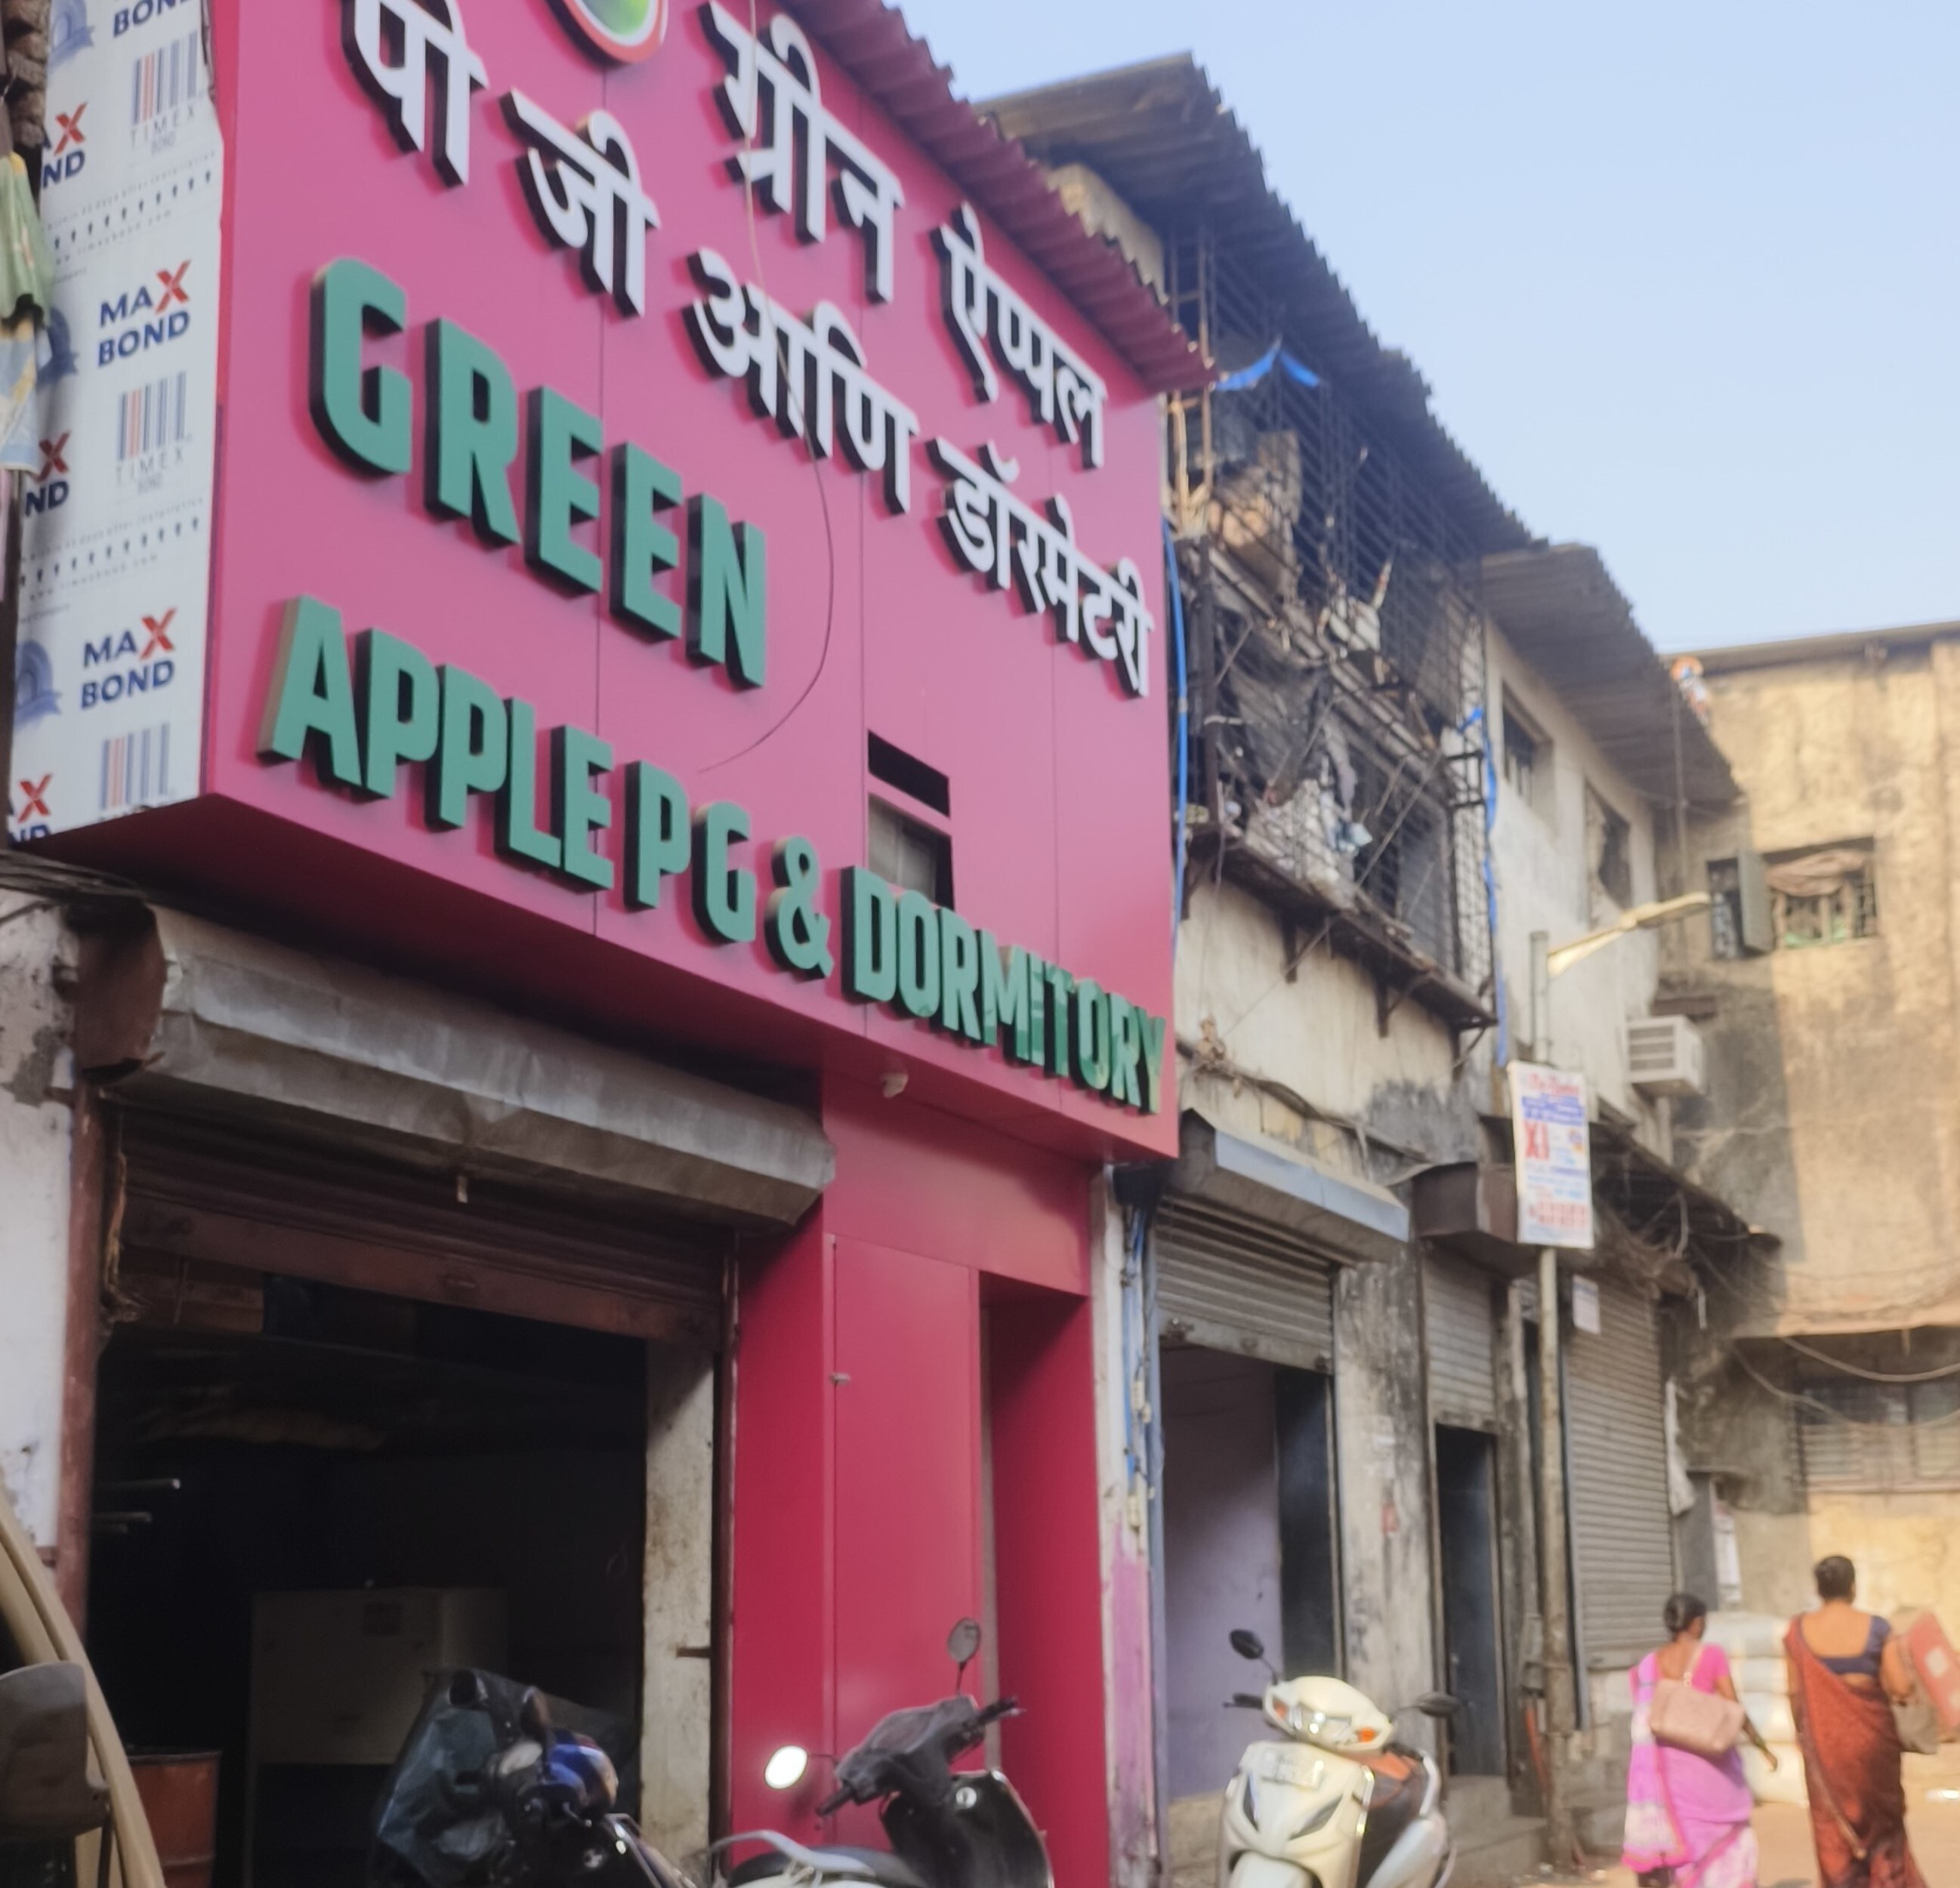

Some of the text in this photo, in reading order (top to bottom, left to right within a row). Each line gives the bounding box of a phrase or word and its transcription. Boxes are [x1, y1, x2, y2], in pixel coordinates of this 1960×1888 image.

[704, 0, 905, 303] ग्रीन
[97, 310, 191, 368] BOND
[100, 261, 192, 328] MAX
[344, 0, 1155, 698] पी जी आणि डॉरमेटरी
[313, 257, 766, 688] GREEN
[80, 659, 176, 710] BOND
[83, 608, 177, 668] MAX
[262, 594, 1166, 1115] APPLE PG & DORMITORY
